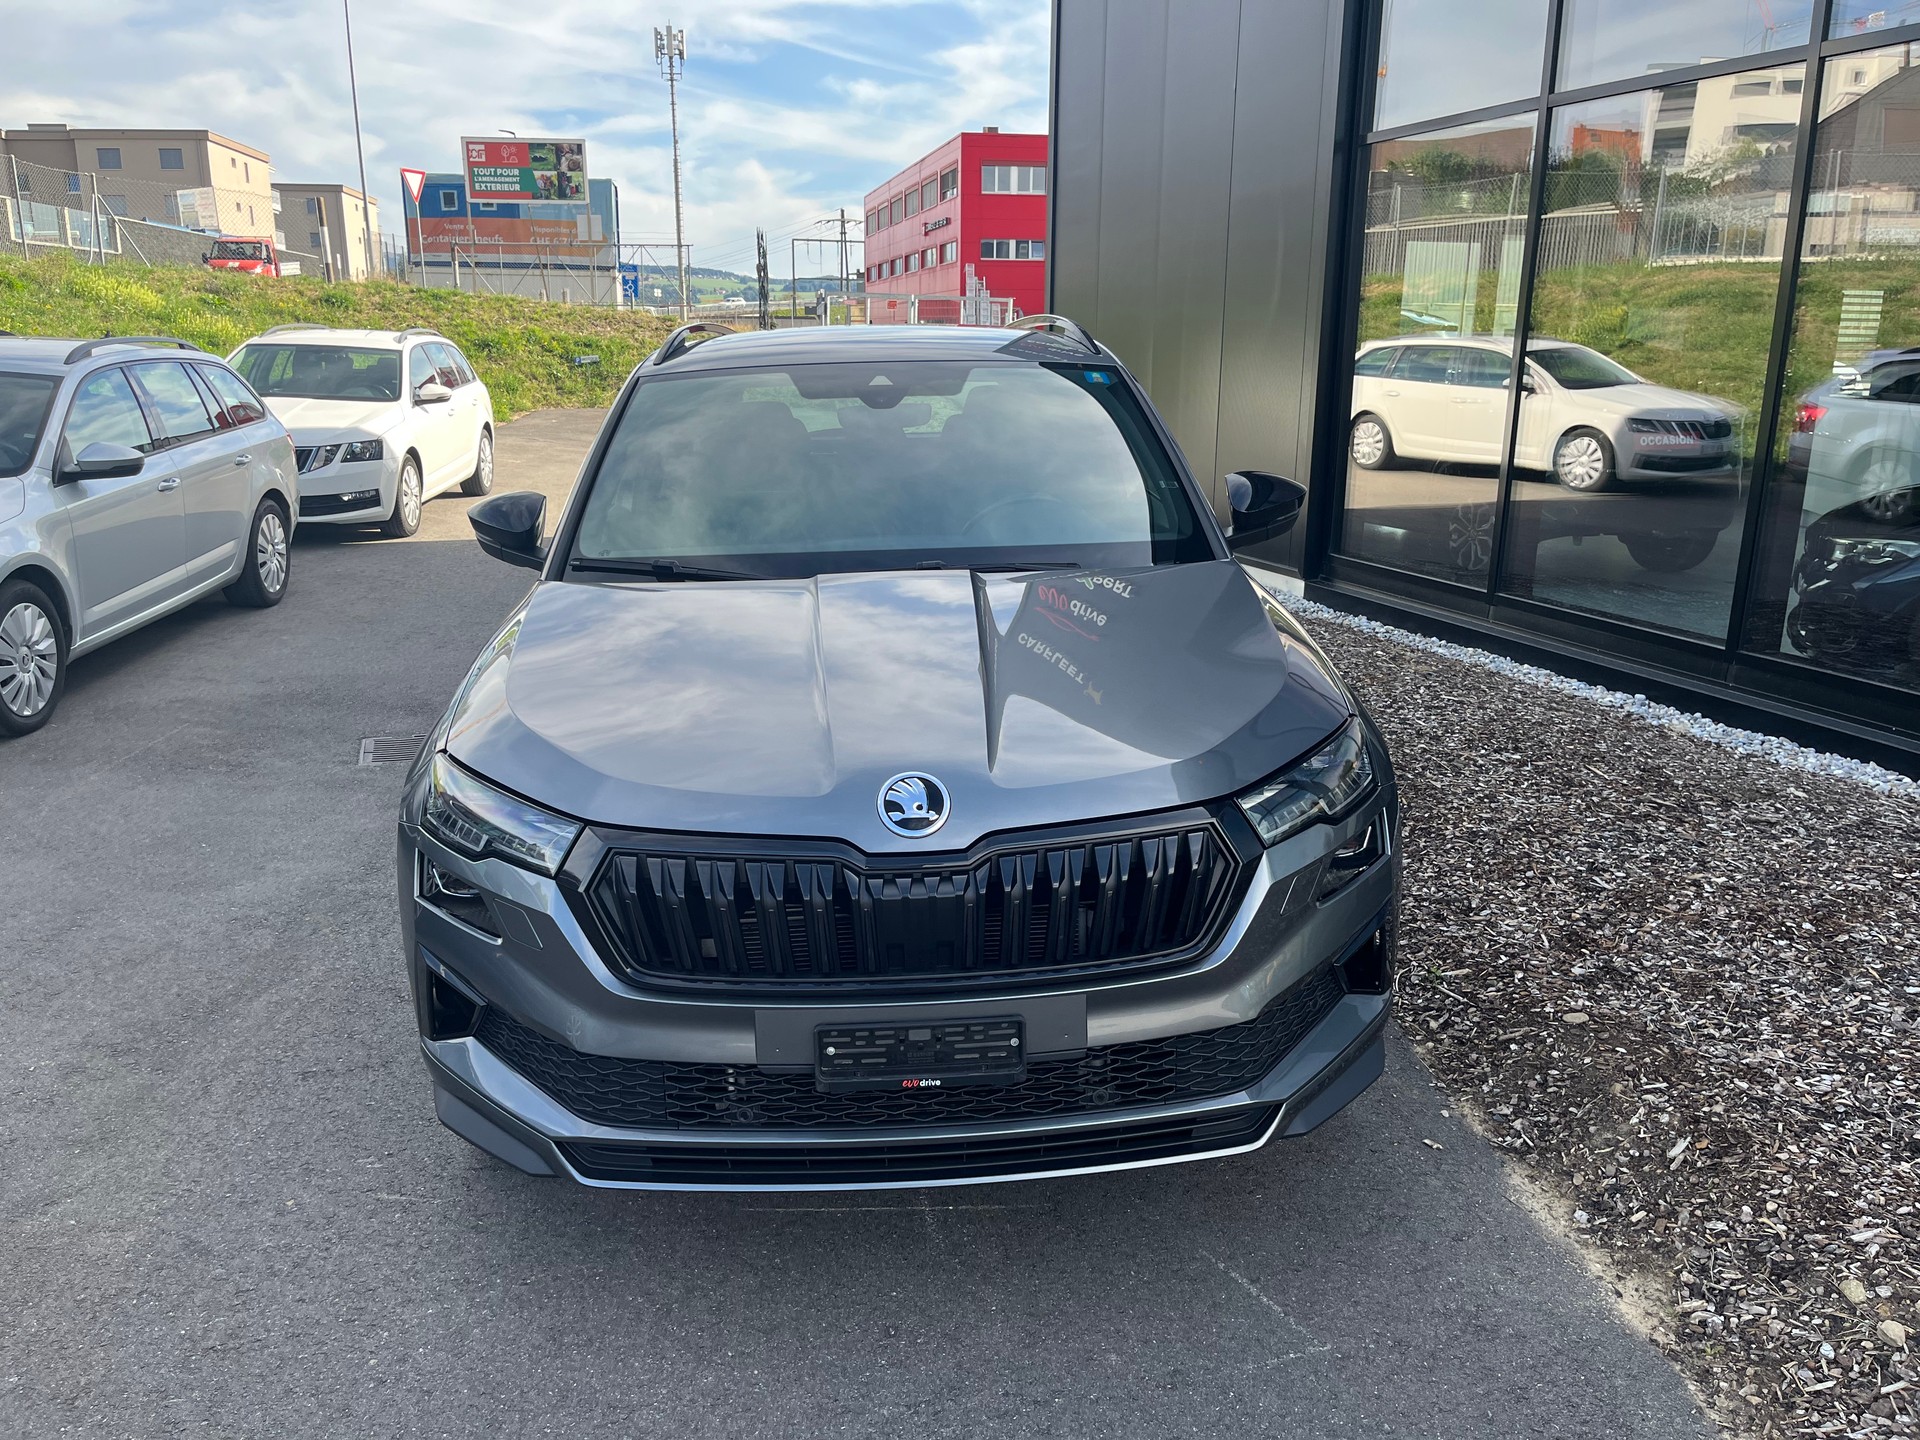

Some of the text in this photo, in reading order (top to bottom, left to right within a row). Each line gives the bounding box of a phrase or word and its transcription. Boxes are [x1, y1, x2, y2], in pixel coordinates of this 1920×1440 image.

[473, 167, 519, 176] TOUT POUR
[475, 183, 520, 191] EXTERIEUR
[1640, 435, 1694, 446] OCCASION
